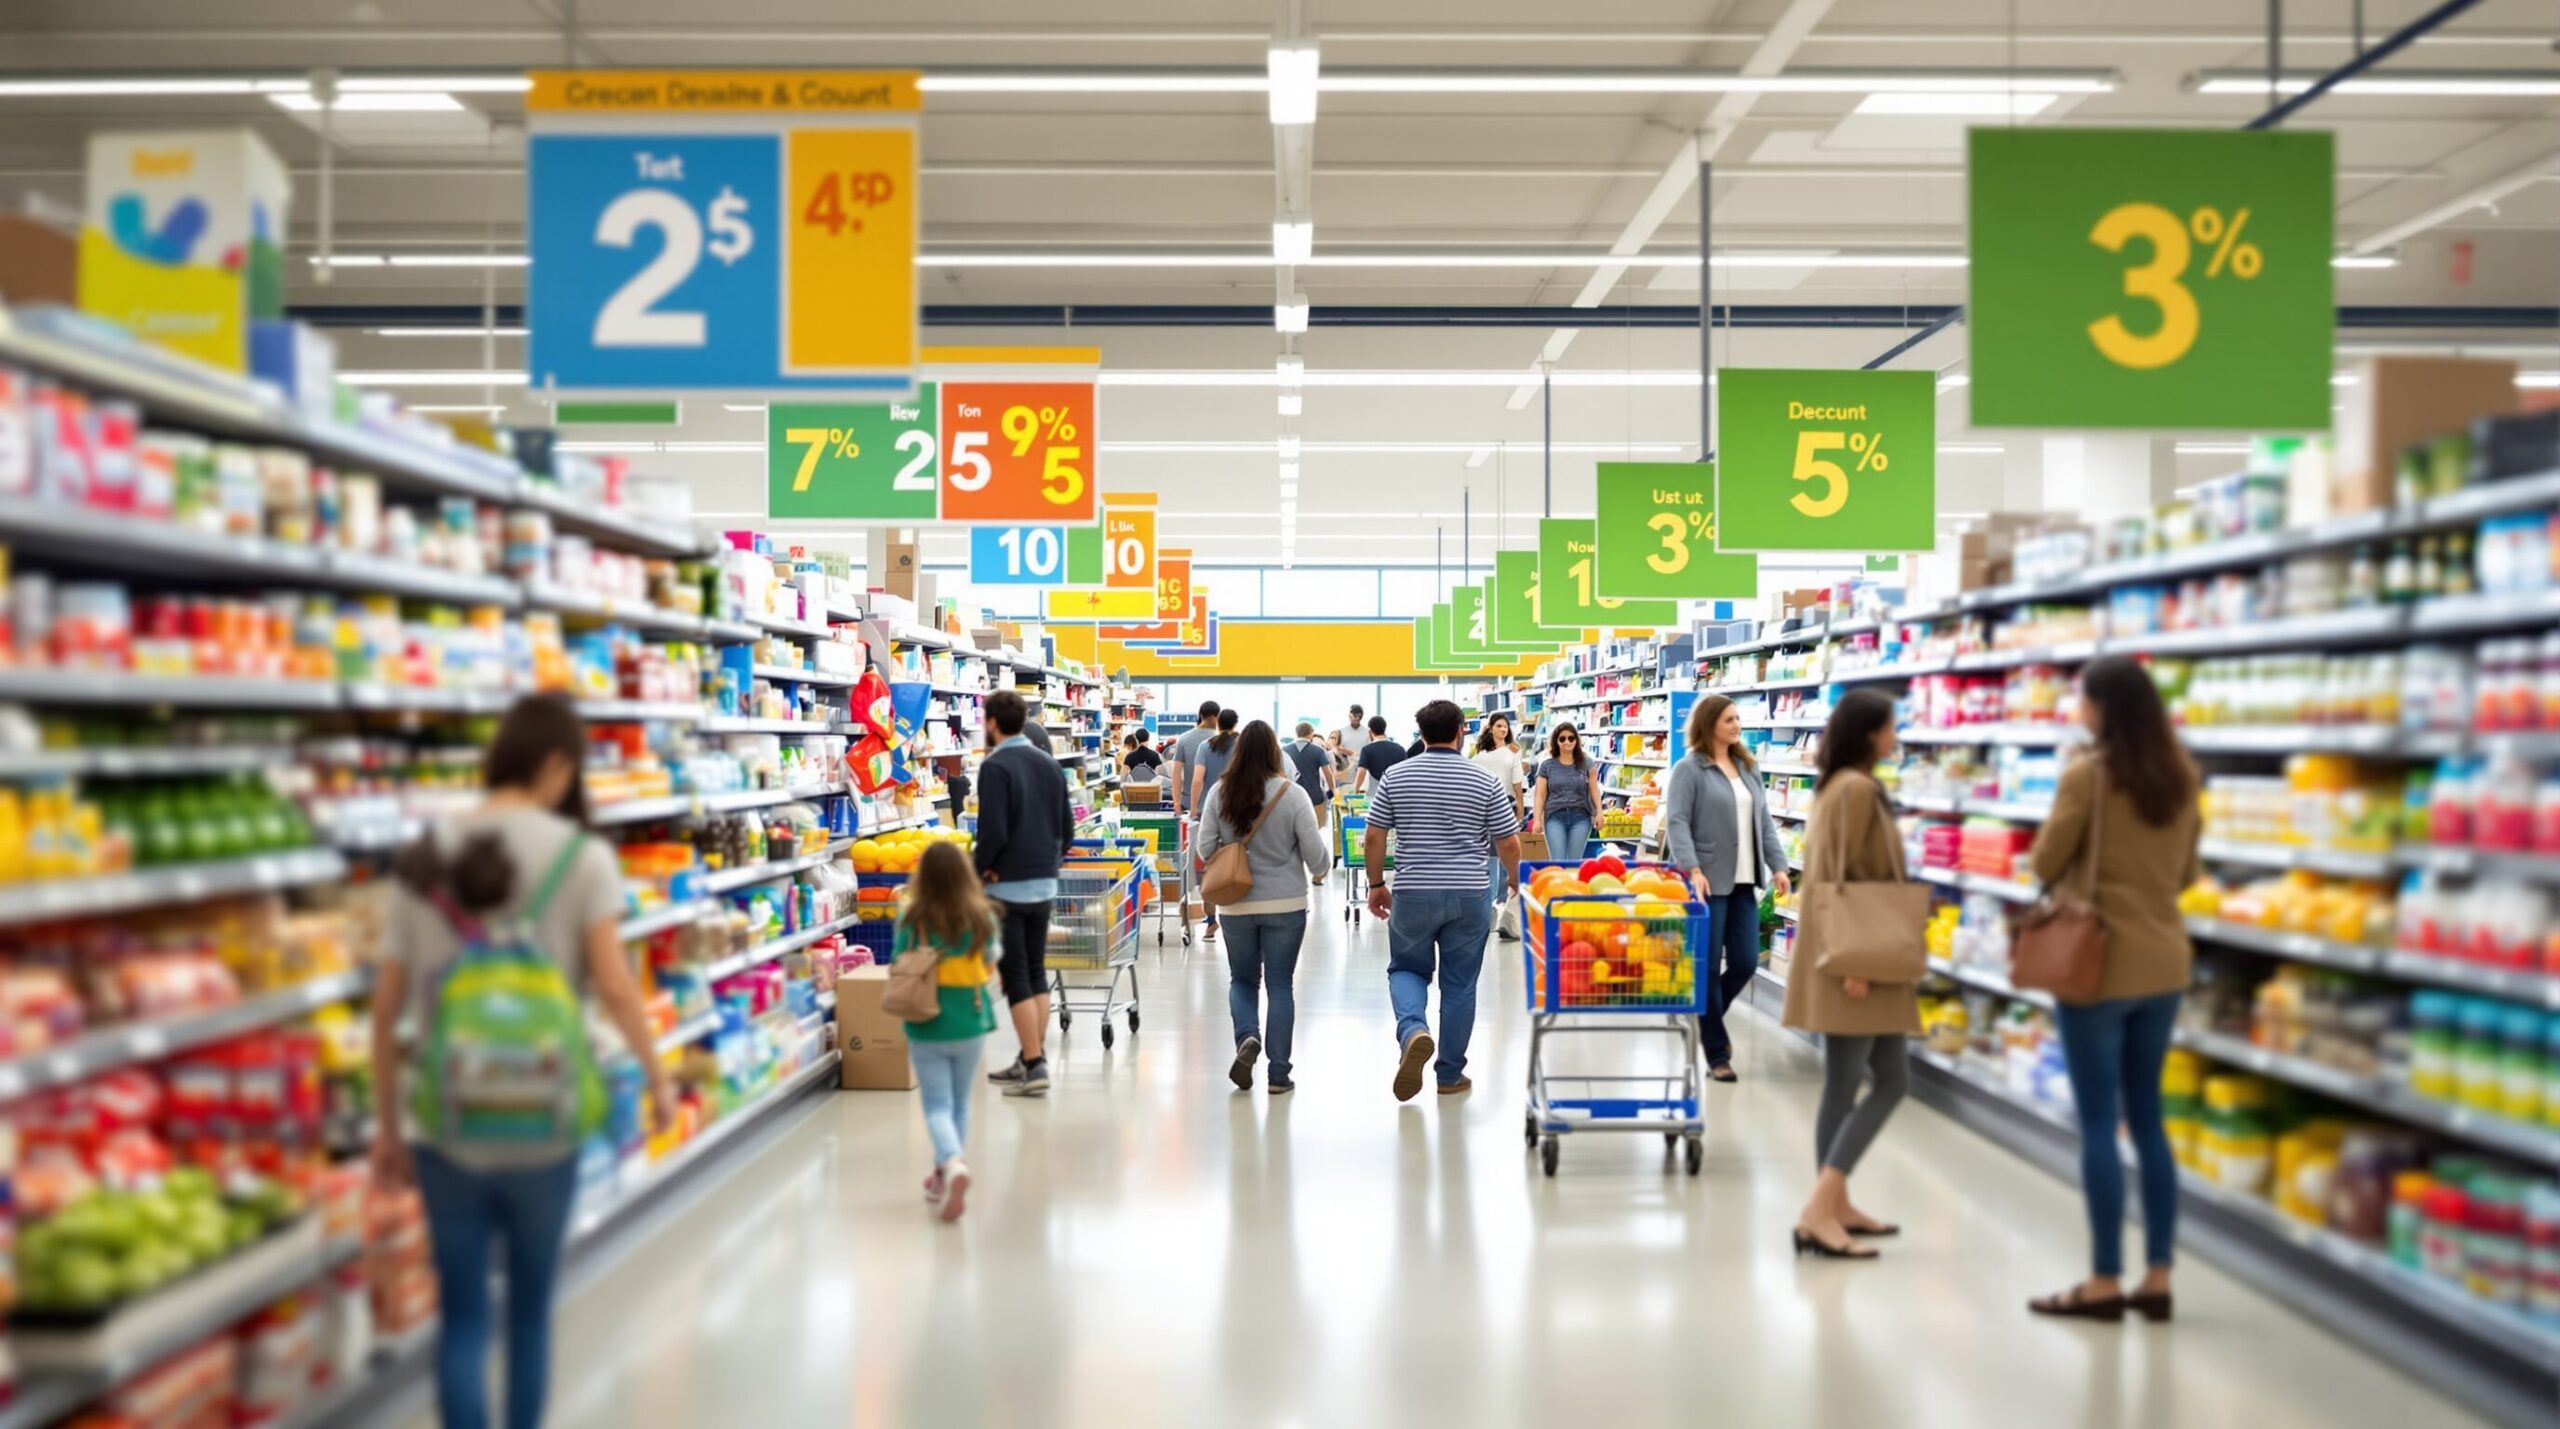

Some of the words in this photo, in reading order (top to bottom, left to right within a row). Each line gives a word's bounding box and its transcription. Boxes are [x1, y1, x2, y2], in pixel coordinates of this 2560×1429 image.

[2087, 202, 2263, 370] 3%
[786, 427, 860, 492] 7%
[1001, 405, 1077, 457] 9%
[1041, 446, 1084, 505] 5
[1789, 430, 1889, 518] 5%
[998, 528, 1060, 576] 10
[1646, 511, 1714, 574] 3%
